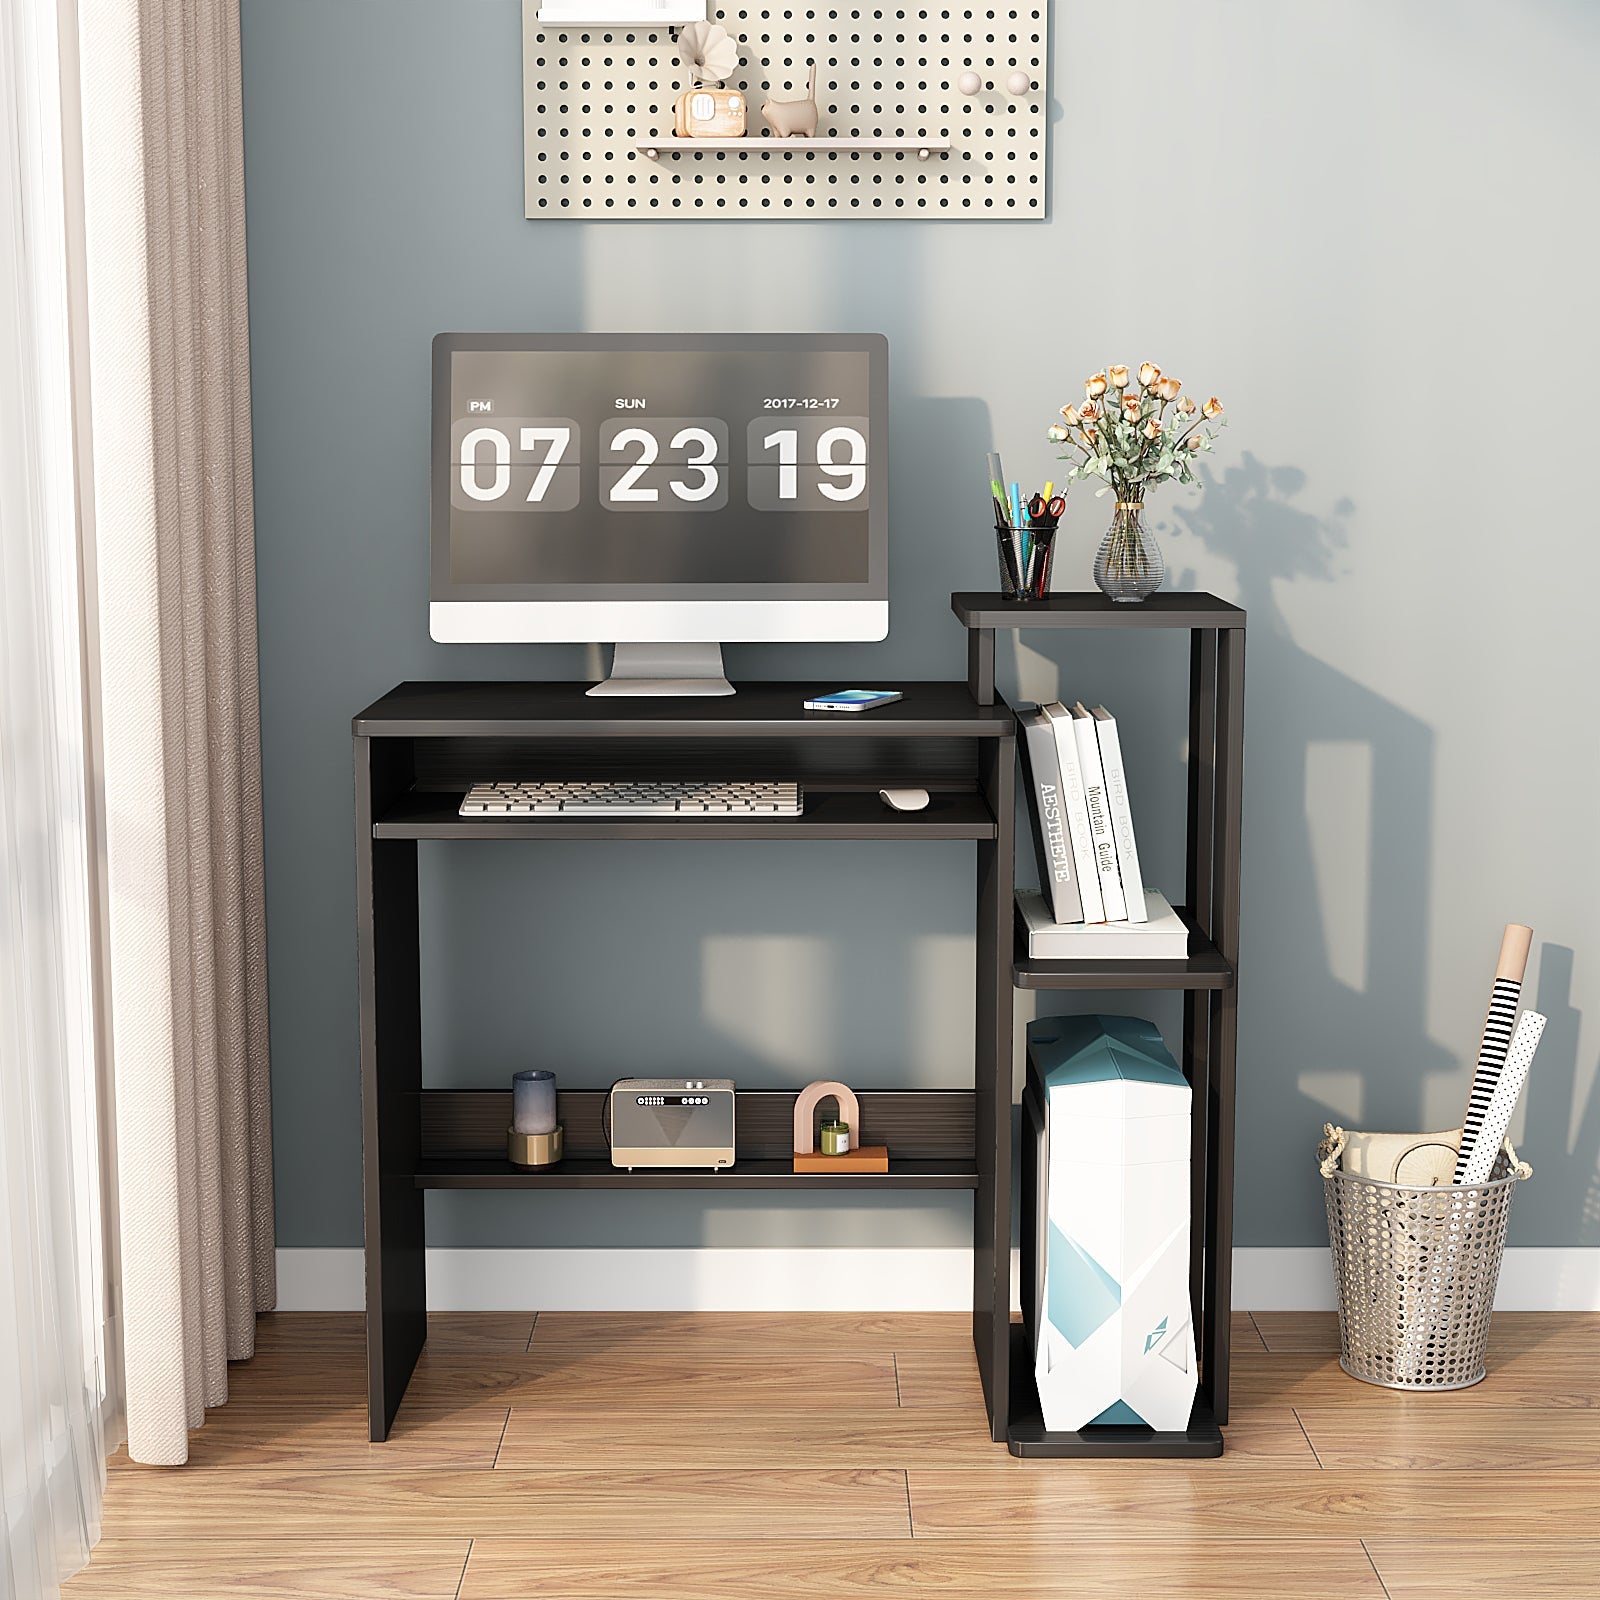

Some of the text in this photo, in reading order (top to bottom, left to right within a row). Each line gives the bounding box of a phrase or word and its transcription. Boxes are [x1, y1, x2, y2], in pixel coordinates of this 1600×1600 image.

[470, 402, 491, 412] PM
[615, 398, 646, 409] SUN
[763, 398, 839, 409] 2017-12-17
[460, 426, 867, 502] 07 23 19
[1040, 783, 1071, 883] AESTHETE
[1064, 761, 1091, 862] BIRD BOOK
[1088, 785, 1112, 872] Mountain Guide
[1111, 768, 1134, 860] BIRD BOOK
